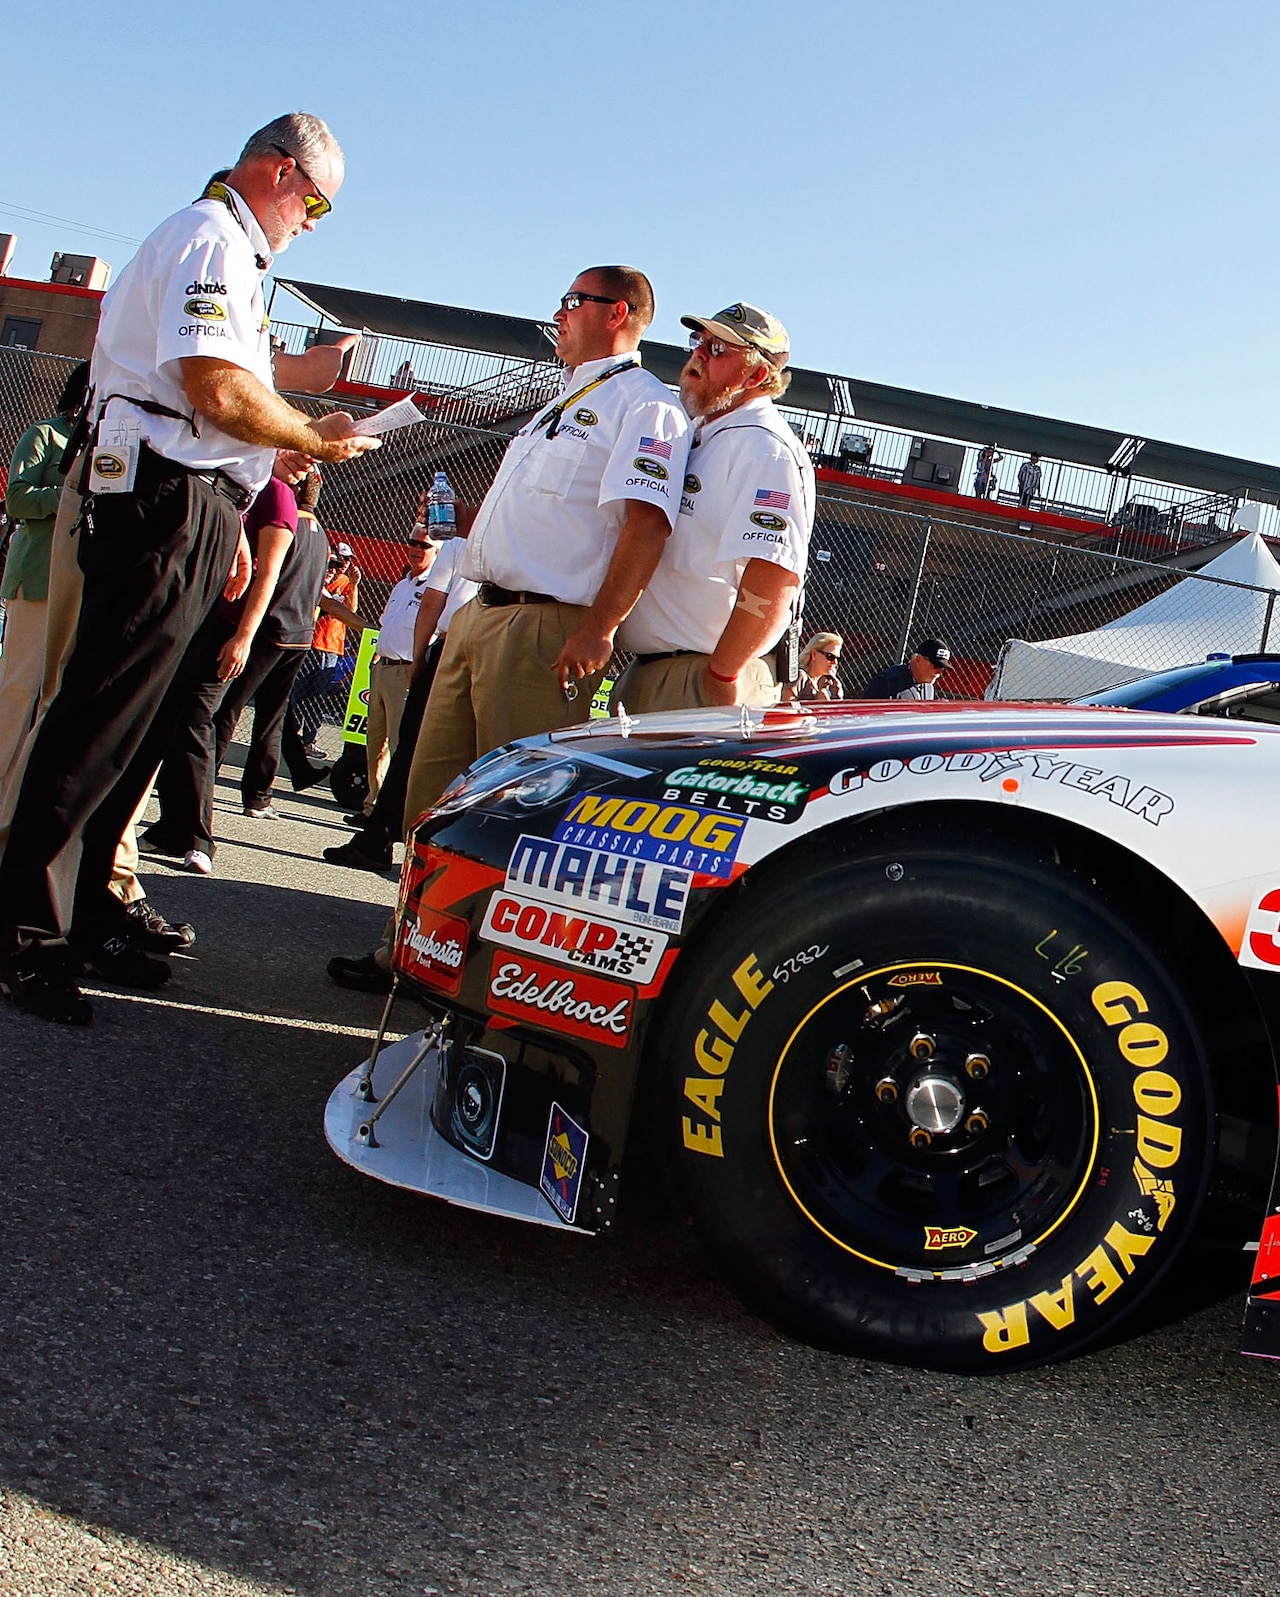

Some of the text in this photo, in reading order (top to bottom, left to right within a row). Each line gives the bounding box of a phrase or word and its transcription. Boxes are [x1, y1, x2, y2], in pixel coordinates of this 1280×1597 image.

[178, 324, 232, 340] OFFICIAL
[625, 478, 670, 498] OFFICIAL
[742, 532, 789, 547] OFFICIAL
[665, 766, 807, 805] Gatorback
[698, 758, 799, 775] GOODYEAR
[663, 788, 787, 820] BELTS
[828, 749, 1174, 827] GOODYEAR
[564, 795, 744, 853] MOOG
[562, 826, 722, 873] CHASSIS PARTS
[508, 838, 690, 920] MAHLE
[403, 916, 464, 968] Raybestos
[490, 898, 618, 953] COMP
[567, 948, 635, 976] CAMS
[772, 944, 830, 983] 5282
[899, 972, 935, 984] AERO
[491, 963, 630, 1034] Edelbrock
[682, 952, 775, 1158] EAGLE
[549, 1136, 578, 1177] SUNOCO
[976, 980, 1182, 1353] GOODYEAR
[931, 1231, 968, 1244] AERO
